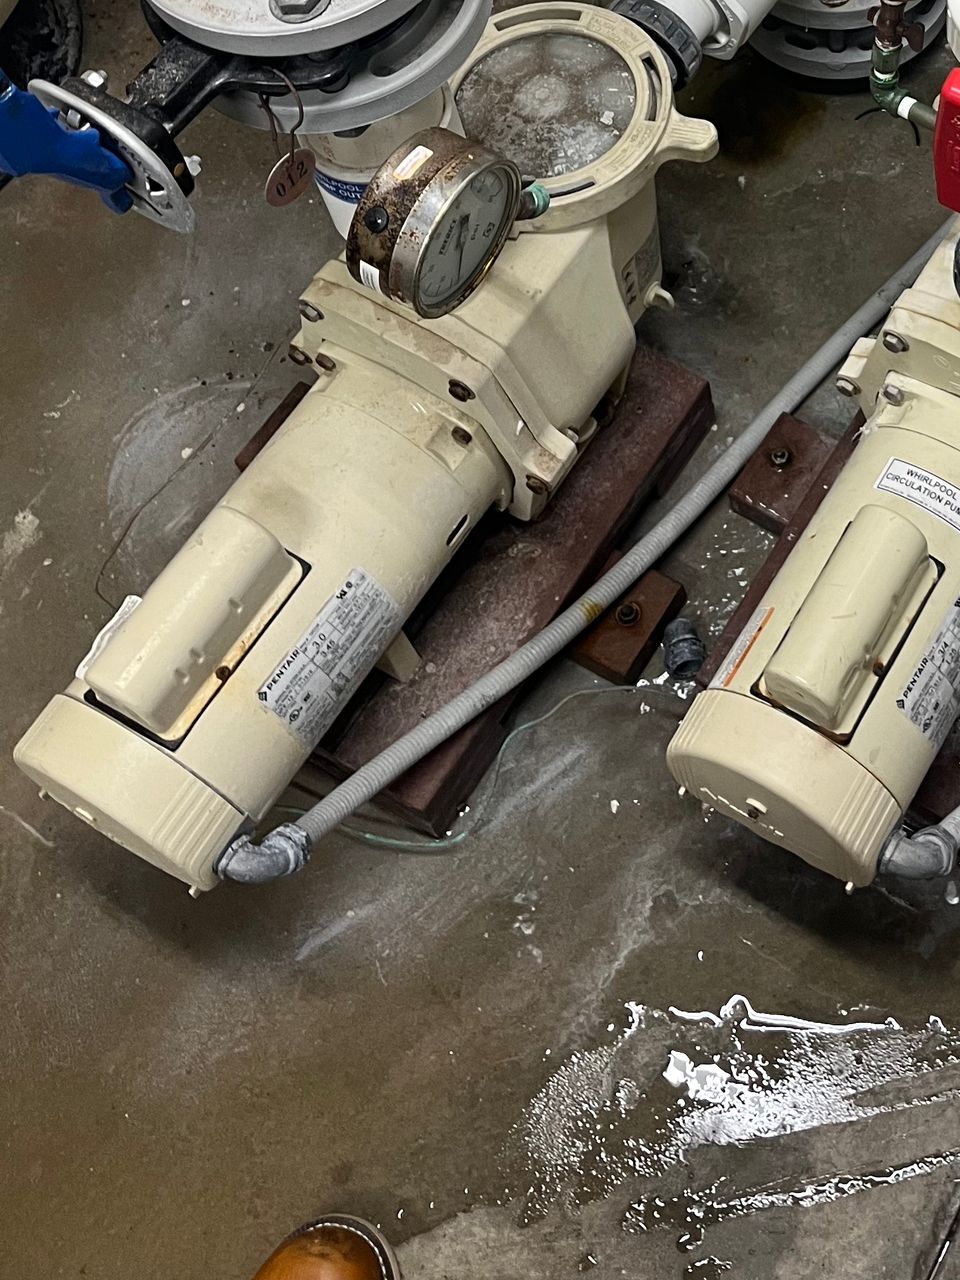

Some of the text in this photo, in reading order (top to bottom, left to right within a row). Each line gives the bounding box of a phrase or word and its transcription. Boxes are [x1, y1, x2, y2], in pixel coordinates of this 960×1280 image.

[276, 161, 308, 197] 012
[340, 190, 361, 199] OUT
[886, 473, 943, 504] CIRCULATION
[906, 468, 958, 501] WHIRLPOOL
[938, 642, 950, 656] 3/4
[266, 649, 301, 691] PENTAIR
[903, 657, 929, 699] PENTAIR
